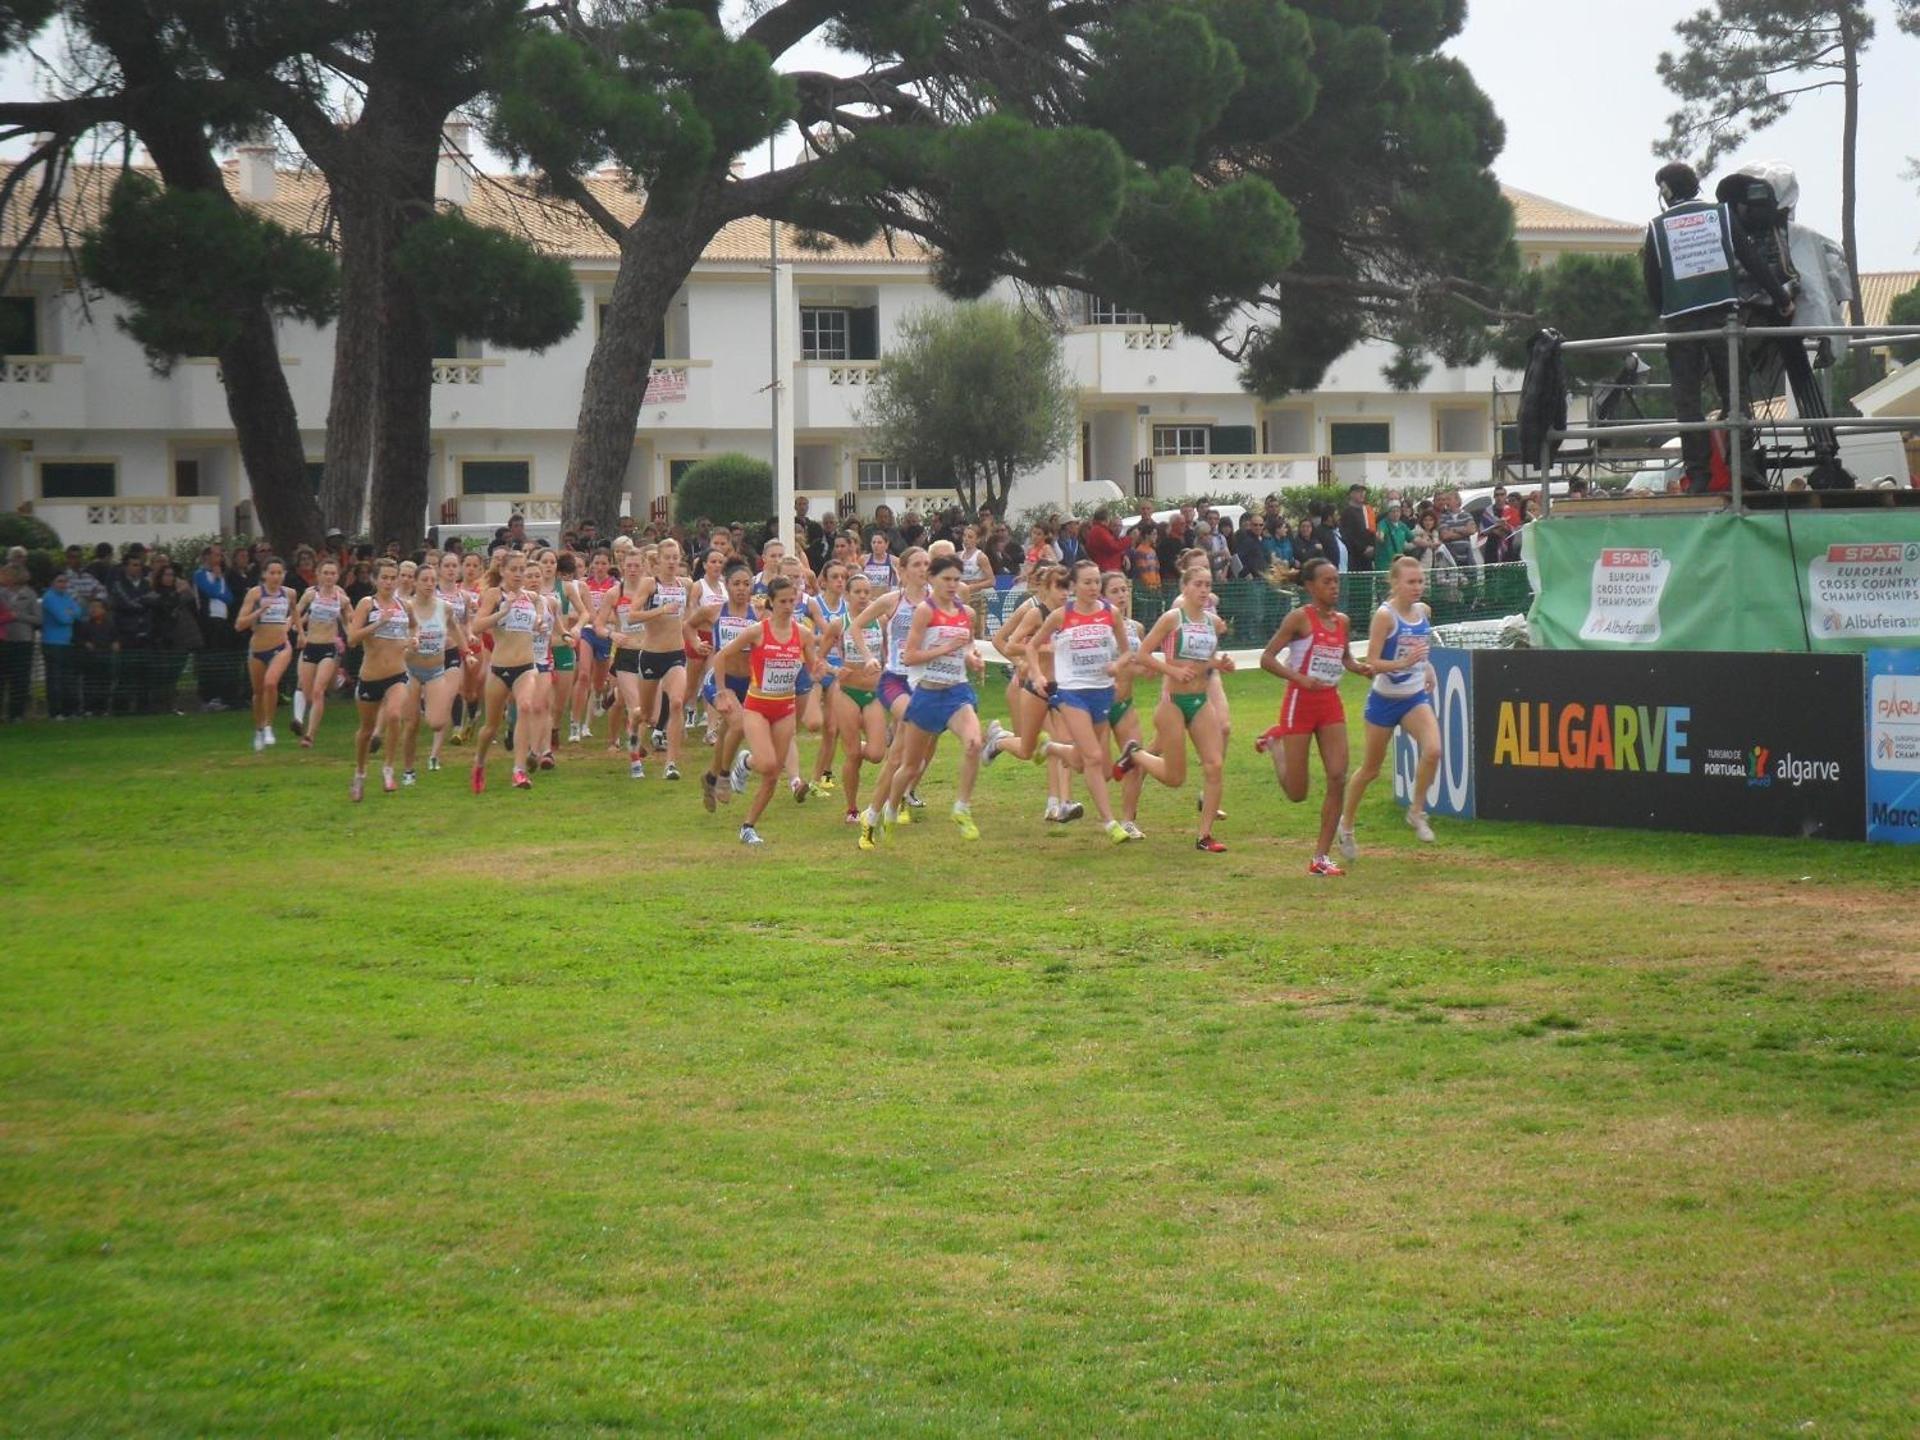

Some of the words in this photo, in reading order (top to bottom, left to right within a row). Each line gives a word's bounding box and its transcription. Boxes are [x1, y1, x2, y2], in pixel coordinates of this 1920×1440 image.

[1612, 552, 1648, 564] SPAR
[1845, 547, 1900, 560] SPAR
[1609, 572, 1650, 582] EUROPEAN
[1837, 566, 1902, 576] EUROPEAN
[1597, 584, 1622, 595] CROSS
[1624, 584, 1658, 595] COUNTRY
[1818, 579, 1857, 590] CROSS
[1861, 577, 1919, 589] COUNTRY
[1821, 589, 1920, 601] CHAMPIONSHIPS
[1494, 701, 1690, 774] ALLGARVE
[1707, 749, 1733, 760] TURISMO
[1704, 763, 1747, 777] PORTUGAL
[1777, 752, 1840, 786] algarve
